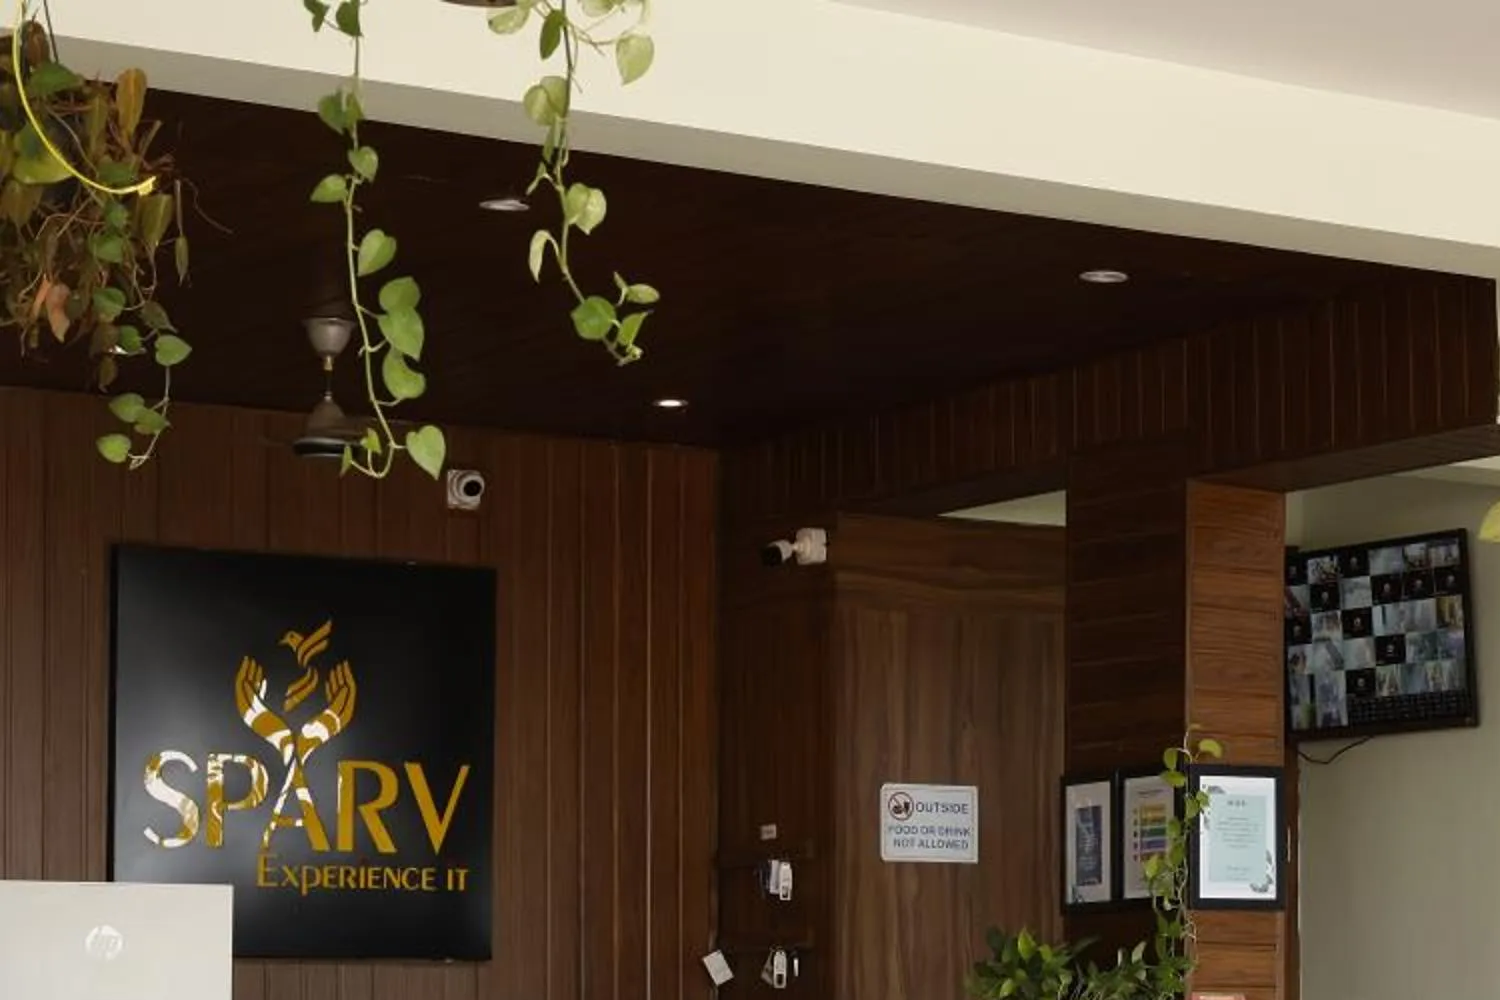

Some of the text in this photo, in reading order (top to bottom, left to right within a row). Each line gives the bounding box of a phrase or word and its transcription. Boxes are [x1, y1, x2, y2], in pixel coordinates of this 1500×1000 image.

[144, 749, 471, 856] SPARV
[915, 801, 970, 815] OUTSIDE
[888, 825, 919, 836] FOOD
[893, 838, 970, 850] NOT ALLOWED
